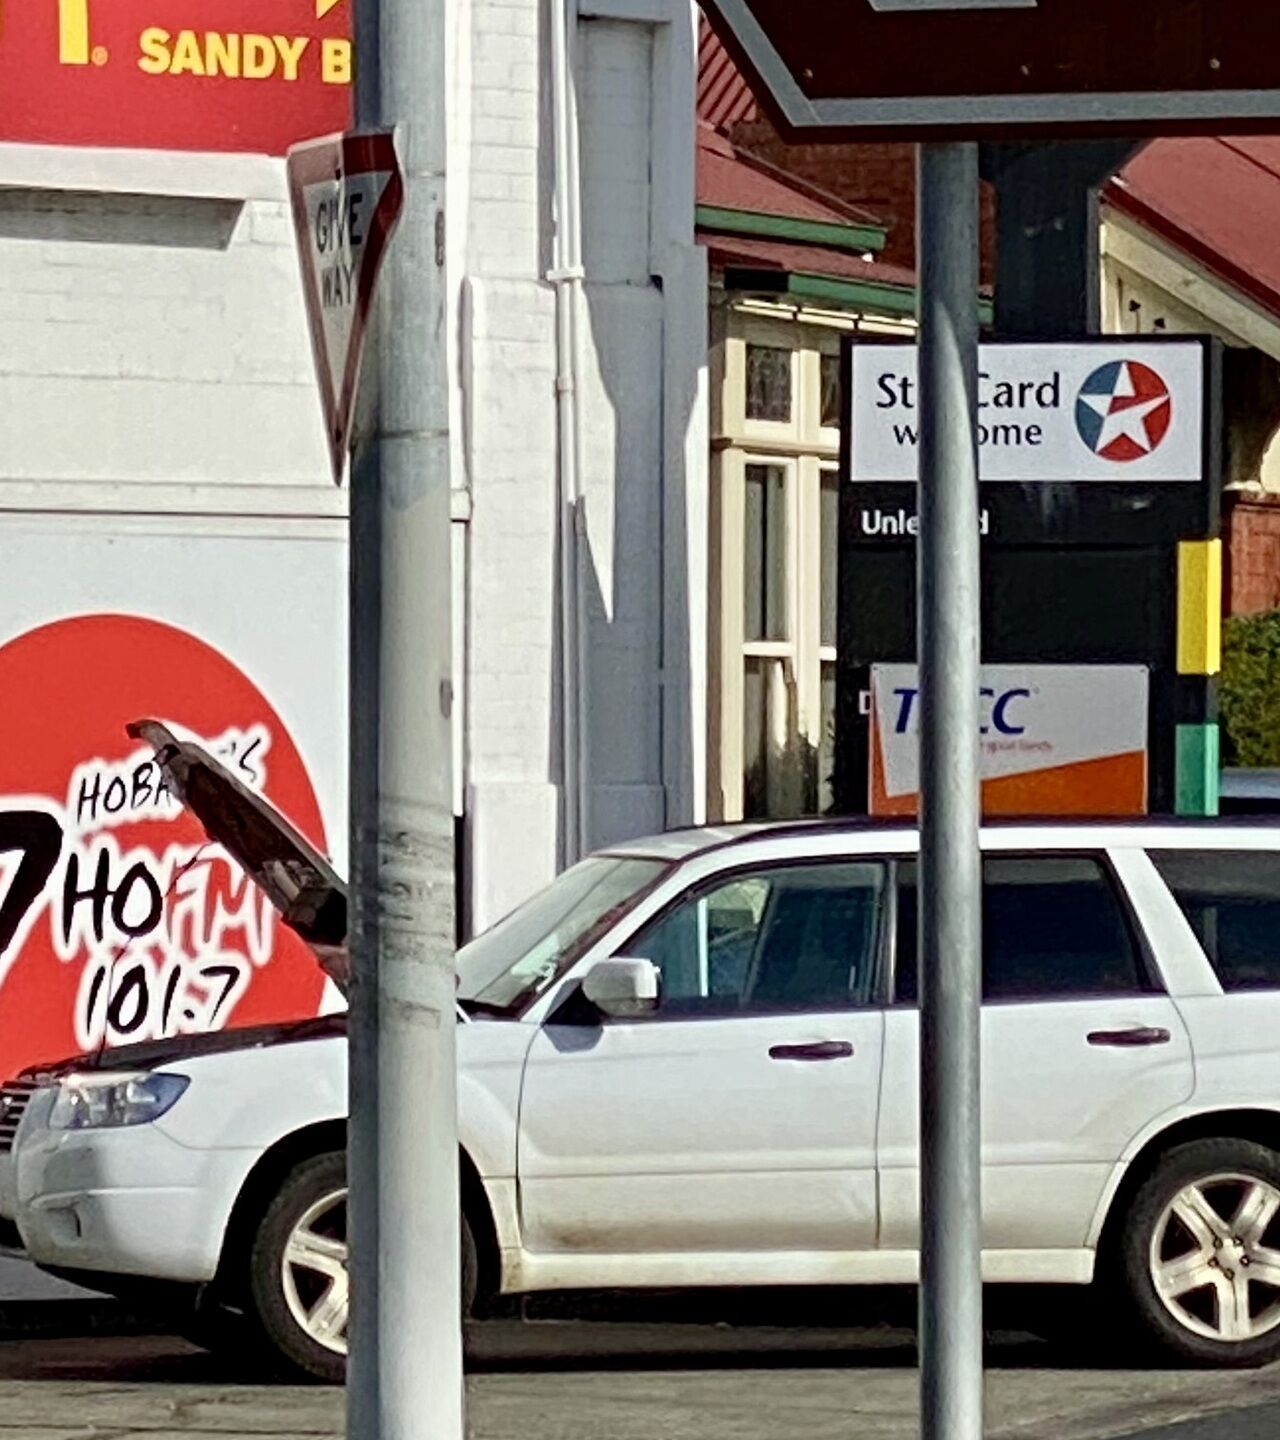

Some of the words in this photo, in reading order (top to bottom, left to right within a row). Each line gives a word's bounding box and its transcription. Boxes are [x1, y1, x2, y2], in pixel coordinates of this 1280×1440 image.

[138, 27, 307, 81] SANDY
[316, 193, 363, 253] GIVE
[894, 423, 1042, 446] wome
[862, 510, 989, 536] Unled
[88, 964, 240, 1035] 101.7
